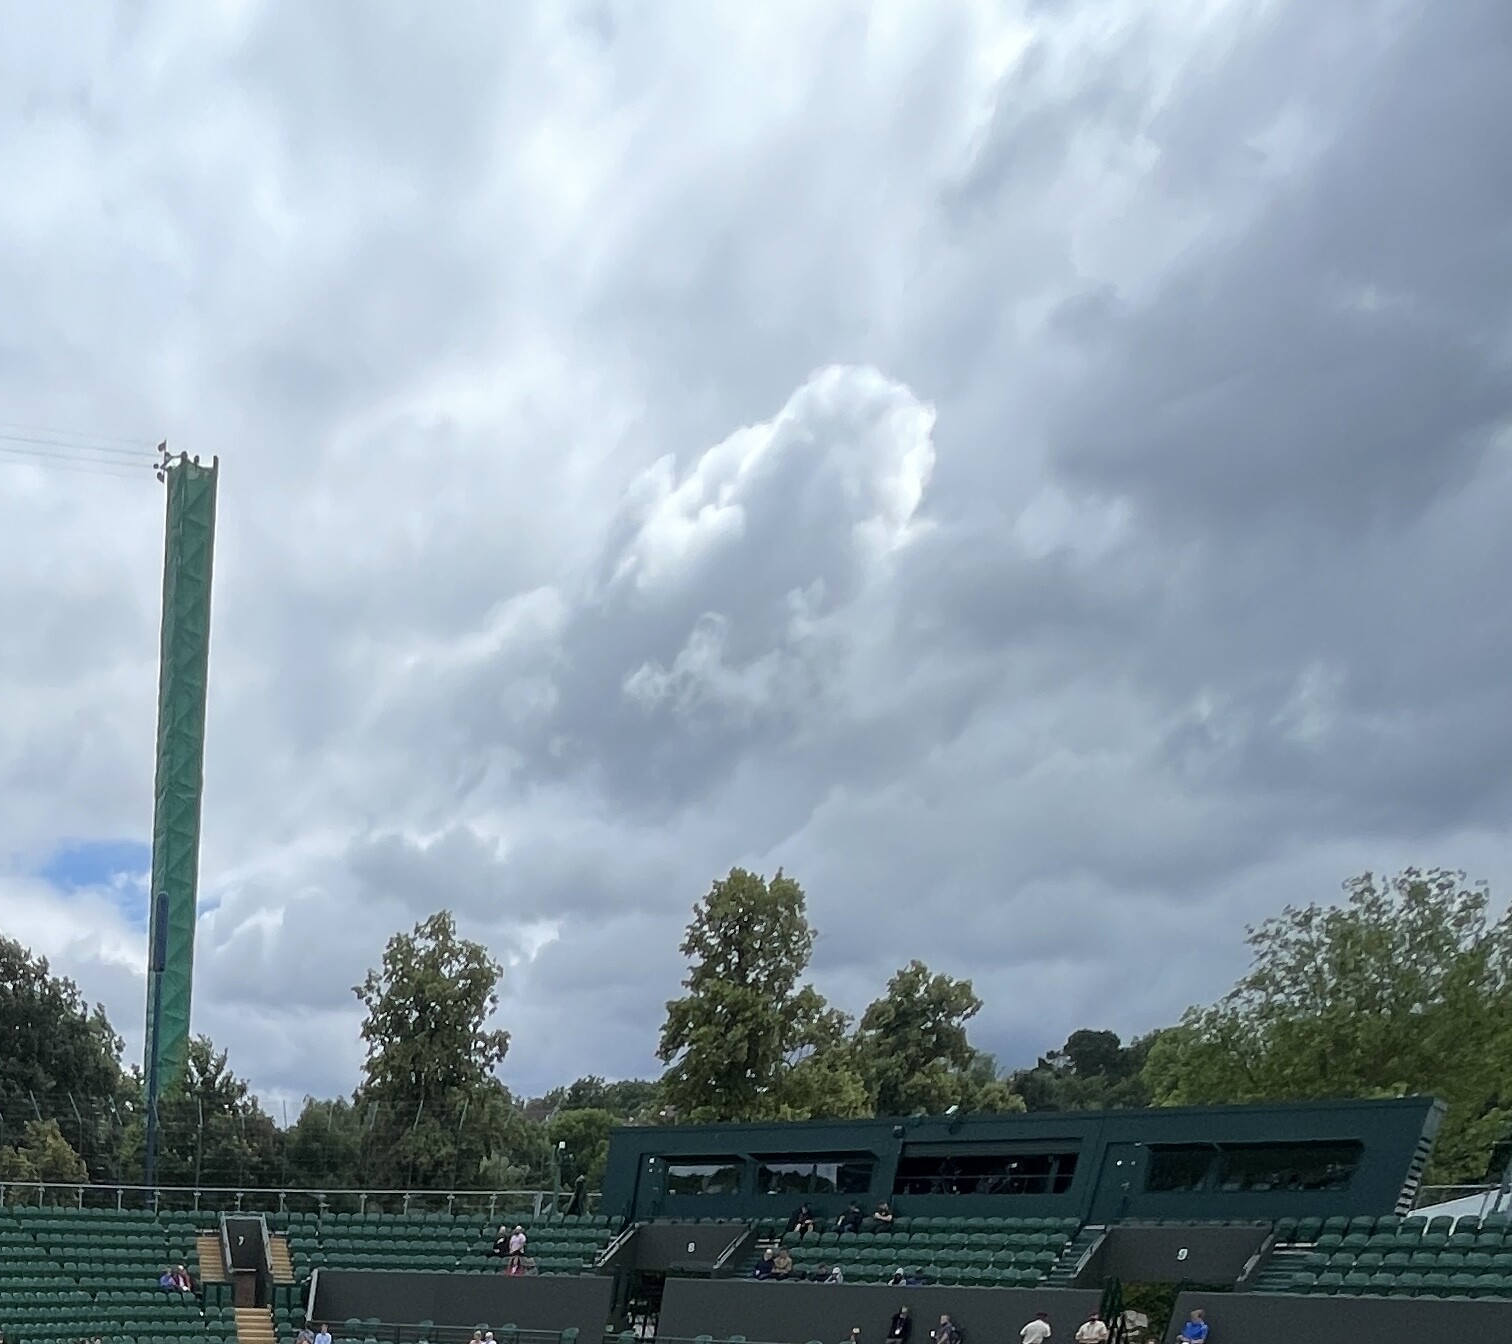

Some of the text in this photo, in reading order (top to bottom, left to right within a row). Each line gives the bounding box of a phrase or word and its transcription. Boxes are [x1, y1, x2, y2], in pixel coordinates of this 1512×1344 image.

[238, 1236, 245, 1246] 7
[688, 1242, 695, 1253] 8
[1177, 1249, 1188, 1260] 9
